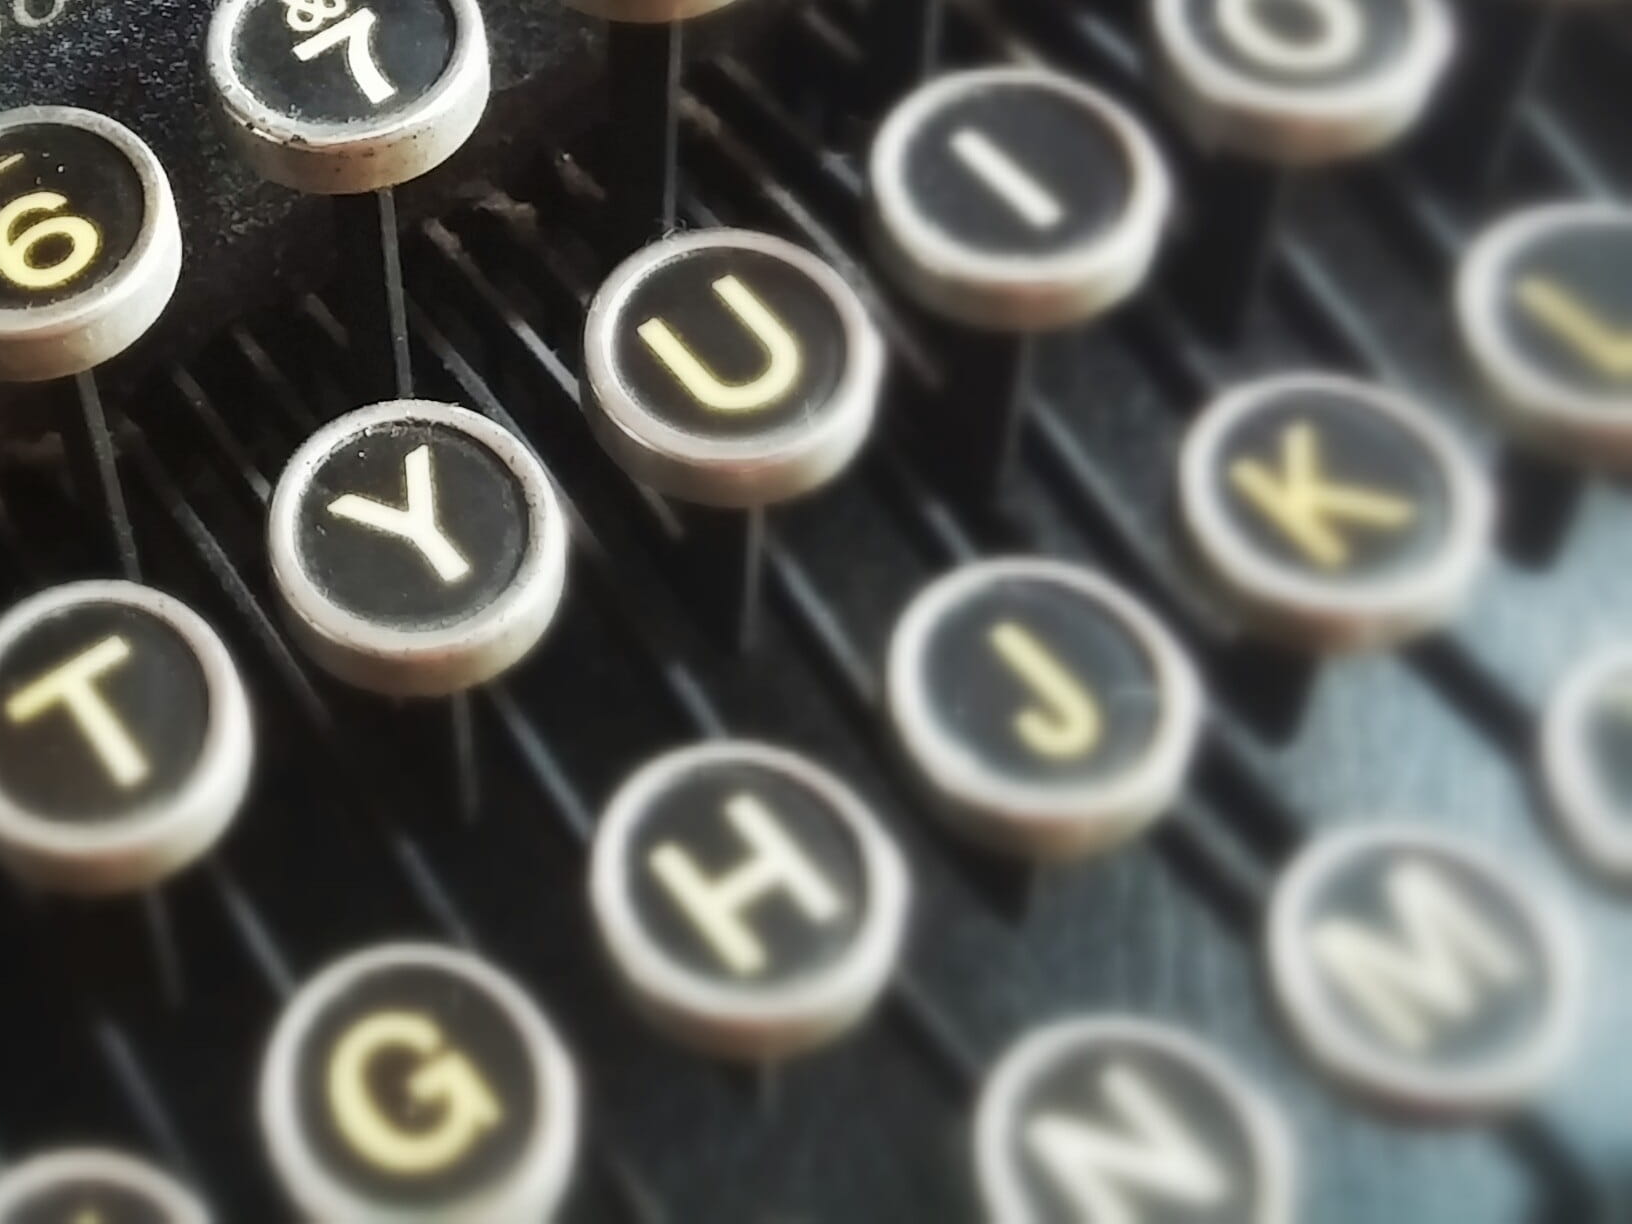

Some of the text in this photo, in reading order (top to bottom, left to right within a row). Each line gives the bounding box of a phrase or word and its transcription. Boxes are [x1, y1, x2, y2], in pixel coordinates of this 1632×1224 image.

[293, 6, 395, 104] 7
[952, 131, 1060, 228] I
[639, 274, 798, 411] U
[327, 444, 470, 582] Y
[1234, 422, 1414, 564] K
[6, 635, 149, 787] T
[993, 624, 1100, 758] J
[652, 794, 842, 972] H
[1316, 863, 1522, 1047] M
[329, 1011, 503, 1170] G
[1029, 1069, 1224, 1224] N
